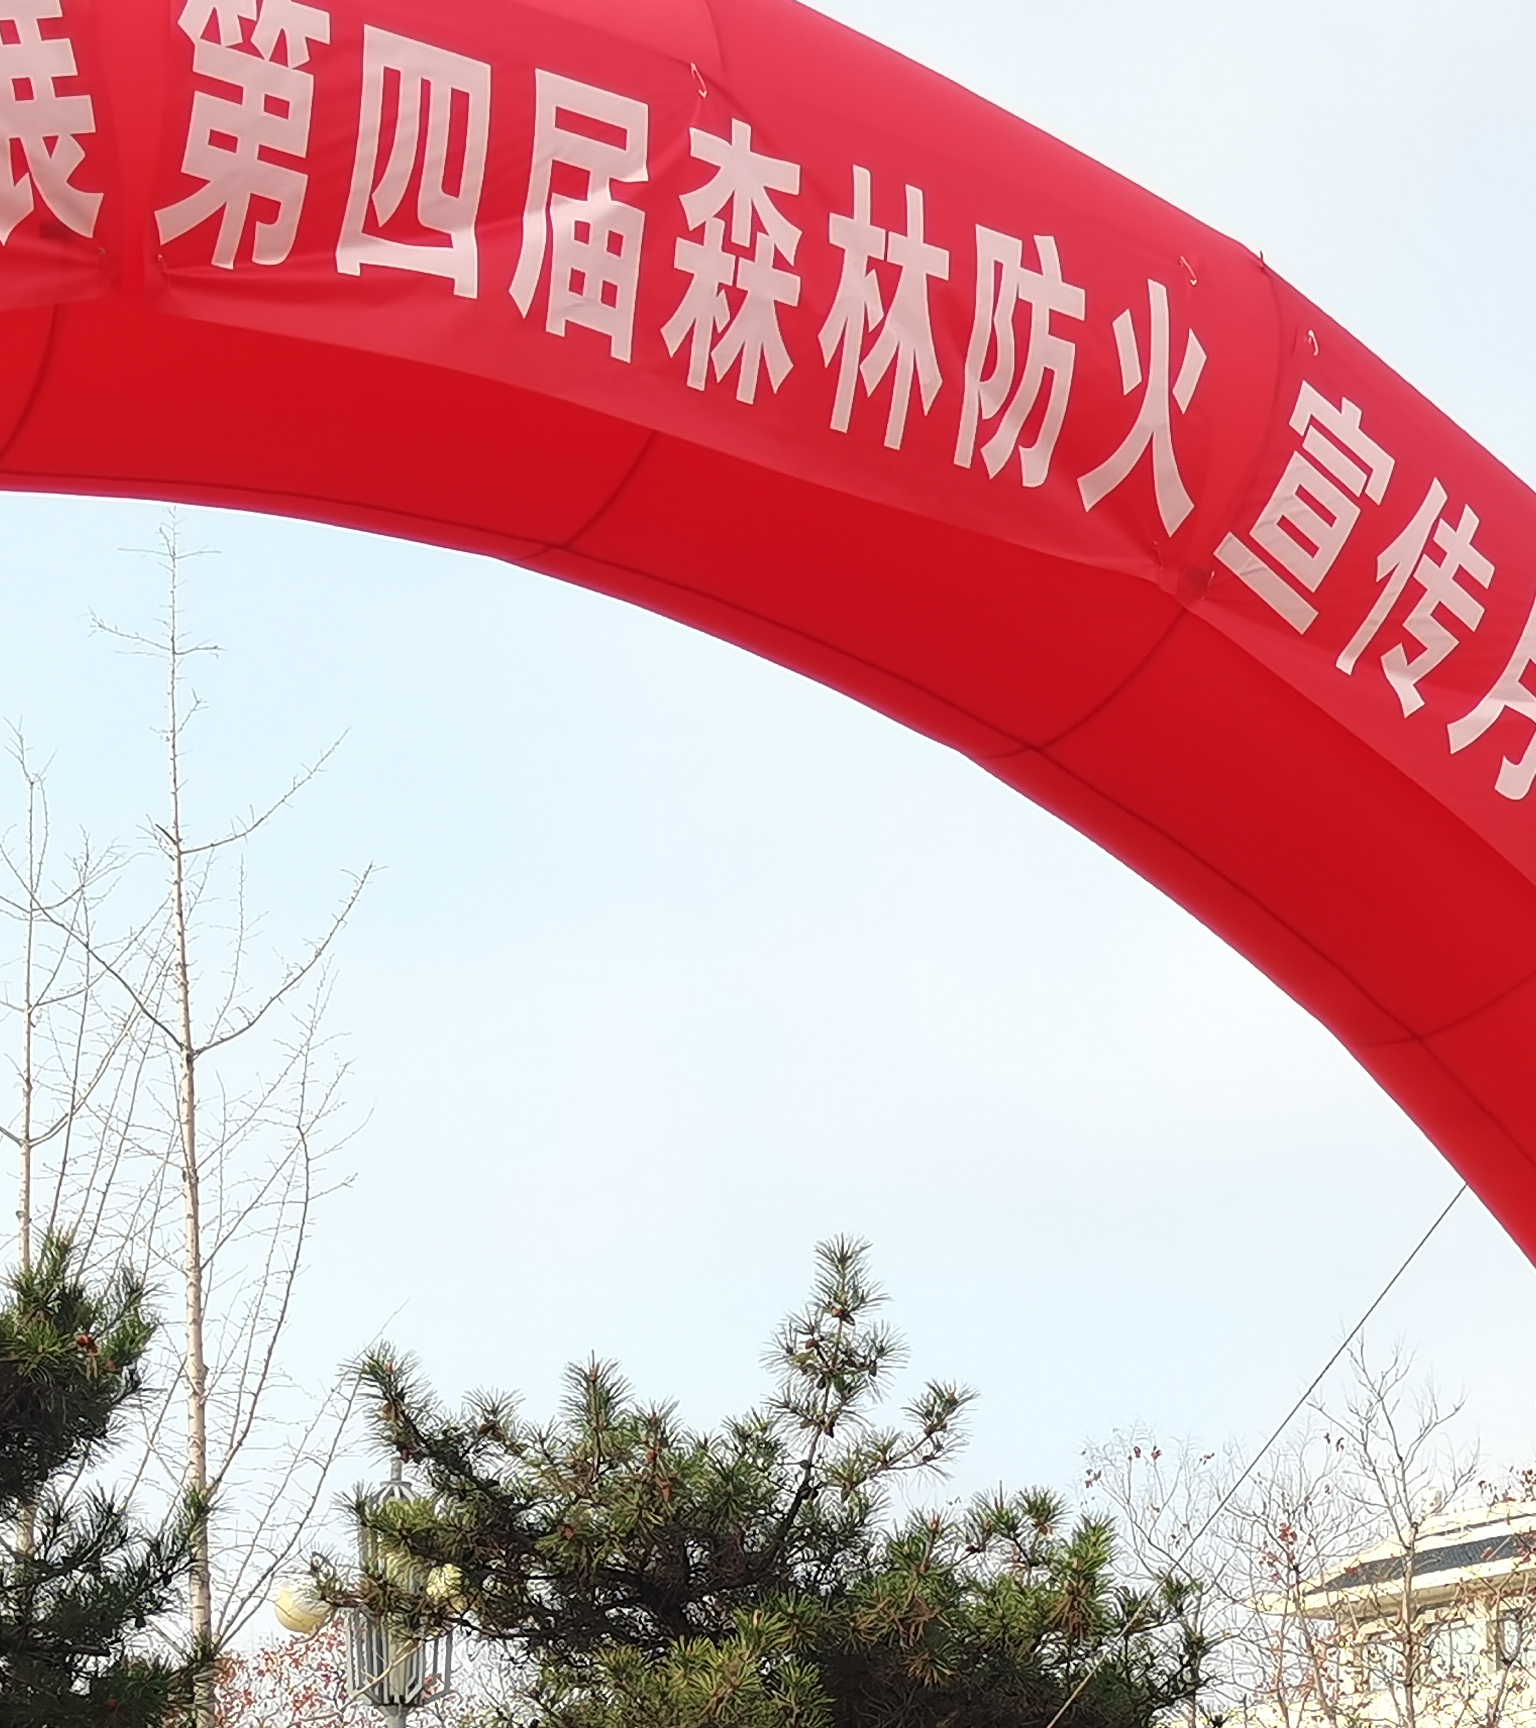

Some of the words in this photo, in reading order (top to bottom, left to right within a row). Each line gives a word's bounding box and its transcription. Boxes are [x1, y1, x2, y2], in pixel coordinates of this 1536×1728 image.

[154, 0, 1207, 538] 第四届森林防火
